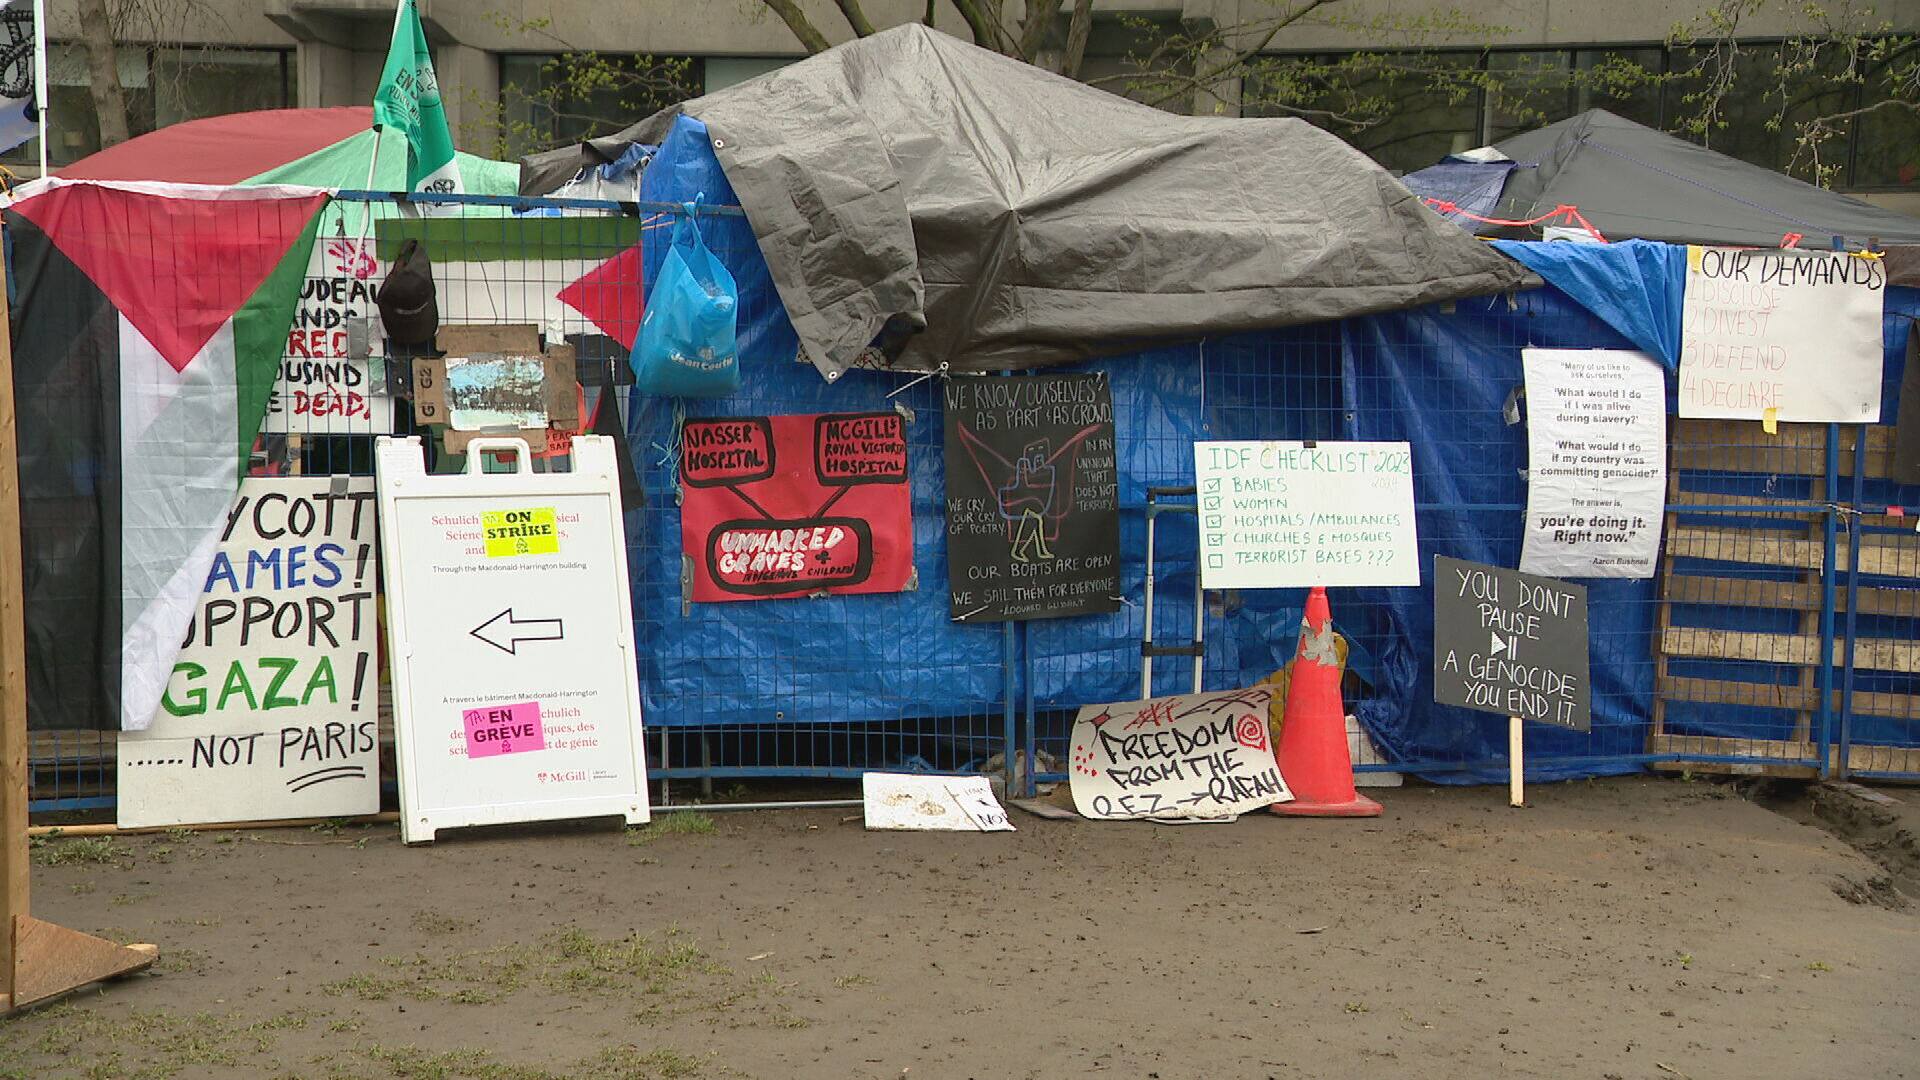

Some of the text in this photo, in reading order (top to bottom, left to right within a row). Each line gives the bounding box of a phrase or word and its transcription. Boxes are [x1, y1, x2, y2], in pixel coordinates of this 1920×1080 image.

[1702, 250, 1883, 290] OUR DEMANDS
[1703, 279, 1781, 309] DISCLOSE
[1704, 307, 1770, 337] DIVEST
[1702, 343, 1787, 371] DEFEND
[946, 379, 1096, 411] WE KNOW OURSELVES
[1588, 389, 1619, 399] would
[1629, 389, 1642, 400] do
[1702, 378, 1784, 410] DECLARE
[1582, 403, 1603, 411] was
[1607, 401, 1631, 411] alive
[976, 411, 997, 431] AS
[1006, 408, 1042, 429] PART
[1053, 405, 1069, 425] AS
[1556, 413, 1590, 425] during
[825, 443, 858, 458] ROYAL
[1099, 438, 1112, 450] AN
[1588, 442, 1619, 452] would
[1629, 443, 1641, 453] do
[687, 450, 765, 472] HOSPITAL
[825, 459, 903, 474] HOSPITAL
[1076, 455, 1114, 470] UNKNOWN
[1208, 448, 1410, 474] IDF CHECKLIST 2023
[1562, 456, 1578, 466] my
[1581, 455, 1620, 467] country
[1624, 457, 1645, 466] was
[1084, 471, 1110, 484] THAT
[1541, 467, 1600, 480] committing
[1075, 484, 1117, 499] DOES NOT
[1232, 477, 1288, 493] BABIES
[948, 497, 986, 513] WE CRY
[1233, 499, 1288, 510] WOMEN
[1571, 498, 1585, 507] The
[1587, 500, 1612, 508] answer
[431, 513, 480, 526] Schulich
[505, 511, 532, 523] ON
[953, 511, 996, 523] OUR CRY
[1540, 516, 1647, 532] you're doing it.
[950, 524, 963, 535] OF
[720, 526, 845, 554] UNMARKED
[1233, 532, 1311, 545] CHURCHES
[1331, 532, 1392, 543] MOSQUES
[1554, 531, 1592, 546] Right
[719, 551, 805, 574] GRAVES
[1234, 549, 1306, 565] TERRORIST
[432, 566, 463, 574] Through
[559, 561, 587, 569] building
[968, 554, 1112, 580] OUR BOATS ARE OPEN
[952, 579, 1115, 606] WE SAIL THEM FOR EVERYONE
[1456, 567, 1499, 603] YOU
[1477, 603, 1540, 640] PAUSE
[1443, 650, 1577, 699] A GENOCIDE
[161, 652, 368, 717] GAZA!
[1464, 680, 1577, 727] YOU END IT.
[488, 709, 513, 724] EN
[577, 722, 595, 732] des
[191, 721, 375, 769] NOT PARIS
[554, 740, 568, 749] de
[570, 738, 598, 750] génie
[1100, 714, 1238, 764] FREEDOM
[551, 771, 586, 782] McGill
[1106, 748, 1244, 790] FROM THE
[1207, 767, 1285, 805] RAFAH
